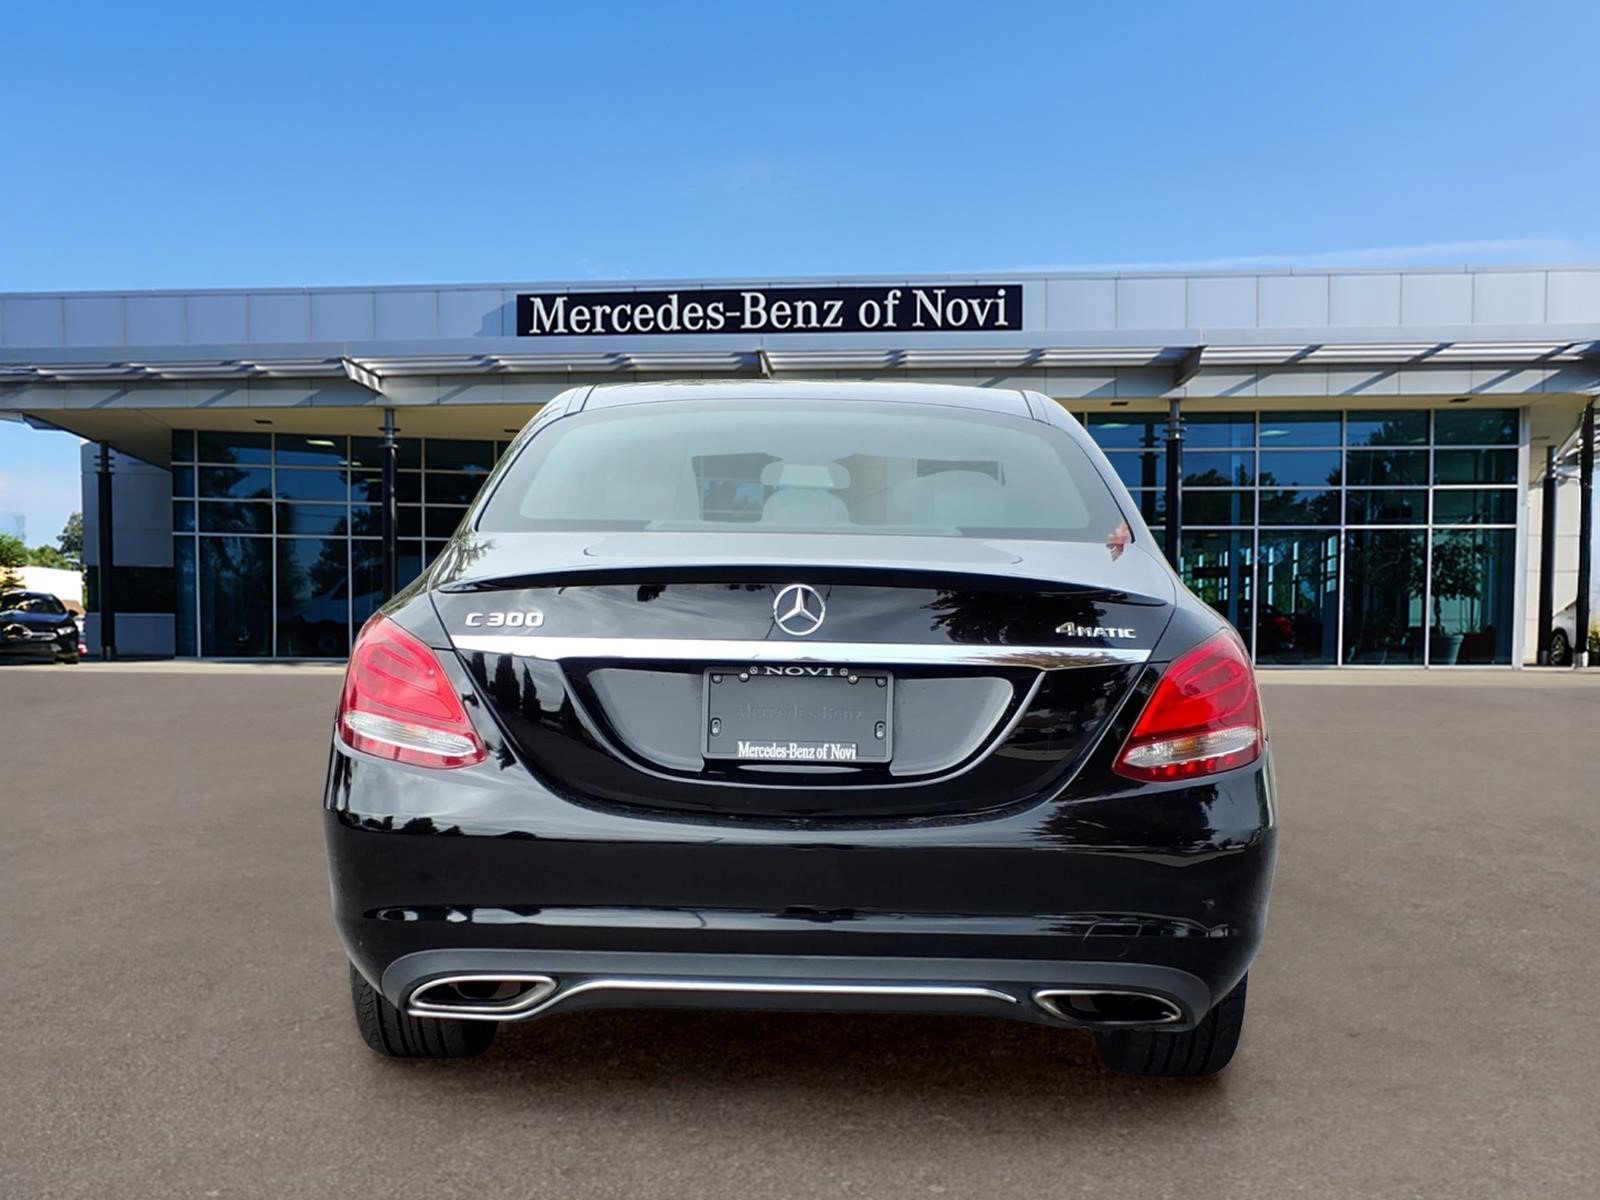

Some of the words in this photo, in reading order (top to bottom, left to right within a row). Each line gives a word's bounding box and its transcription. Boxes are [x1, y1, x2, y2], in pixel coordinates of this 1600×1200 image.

[529, 291, 844, 334] Mercedes-Benz
[858, 289, 901, 328] of
[912, 288, 1009, 327] Novi
[465, 612, 484, 627] C
[486, 612, 544, 627] 300
[1055, 621, 1137, 639] 4MATIC
[764, 666, 835, 677] NOVI
[737, 741, 815, 759] Mercedes-Benz
[816, 743, 828, 759] of
[830, 743, 857, 760] Novi
